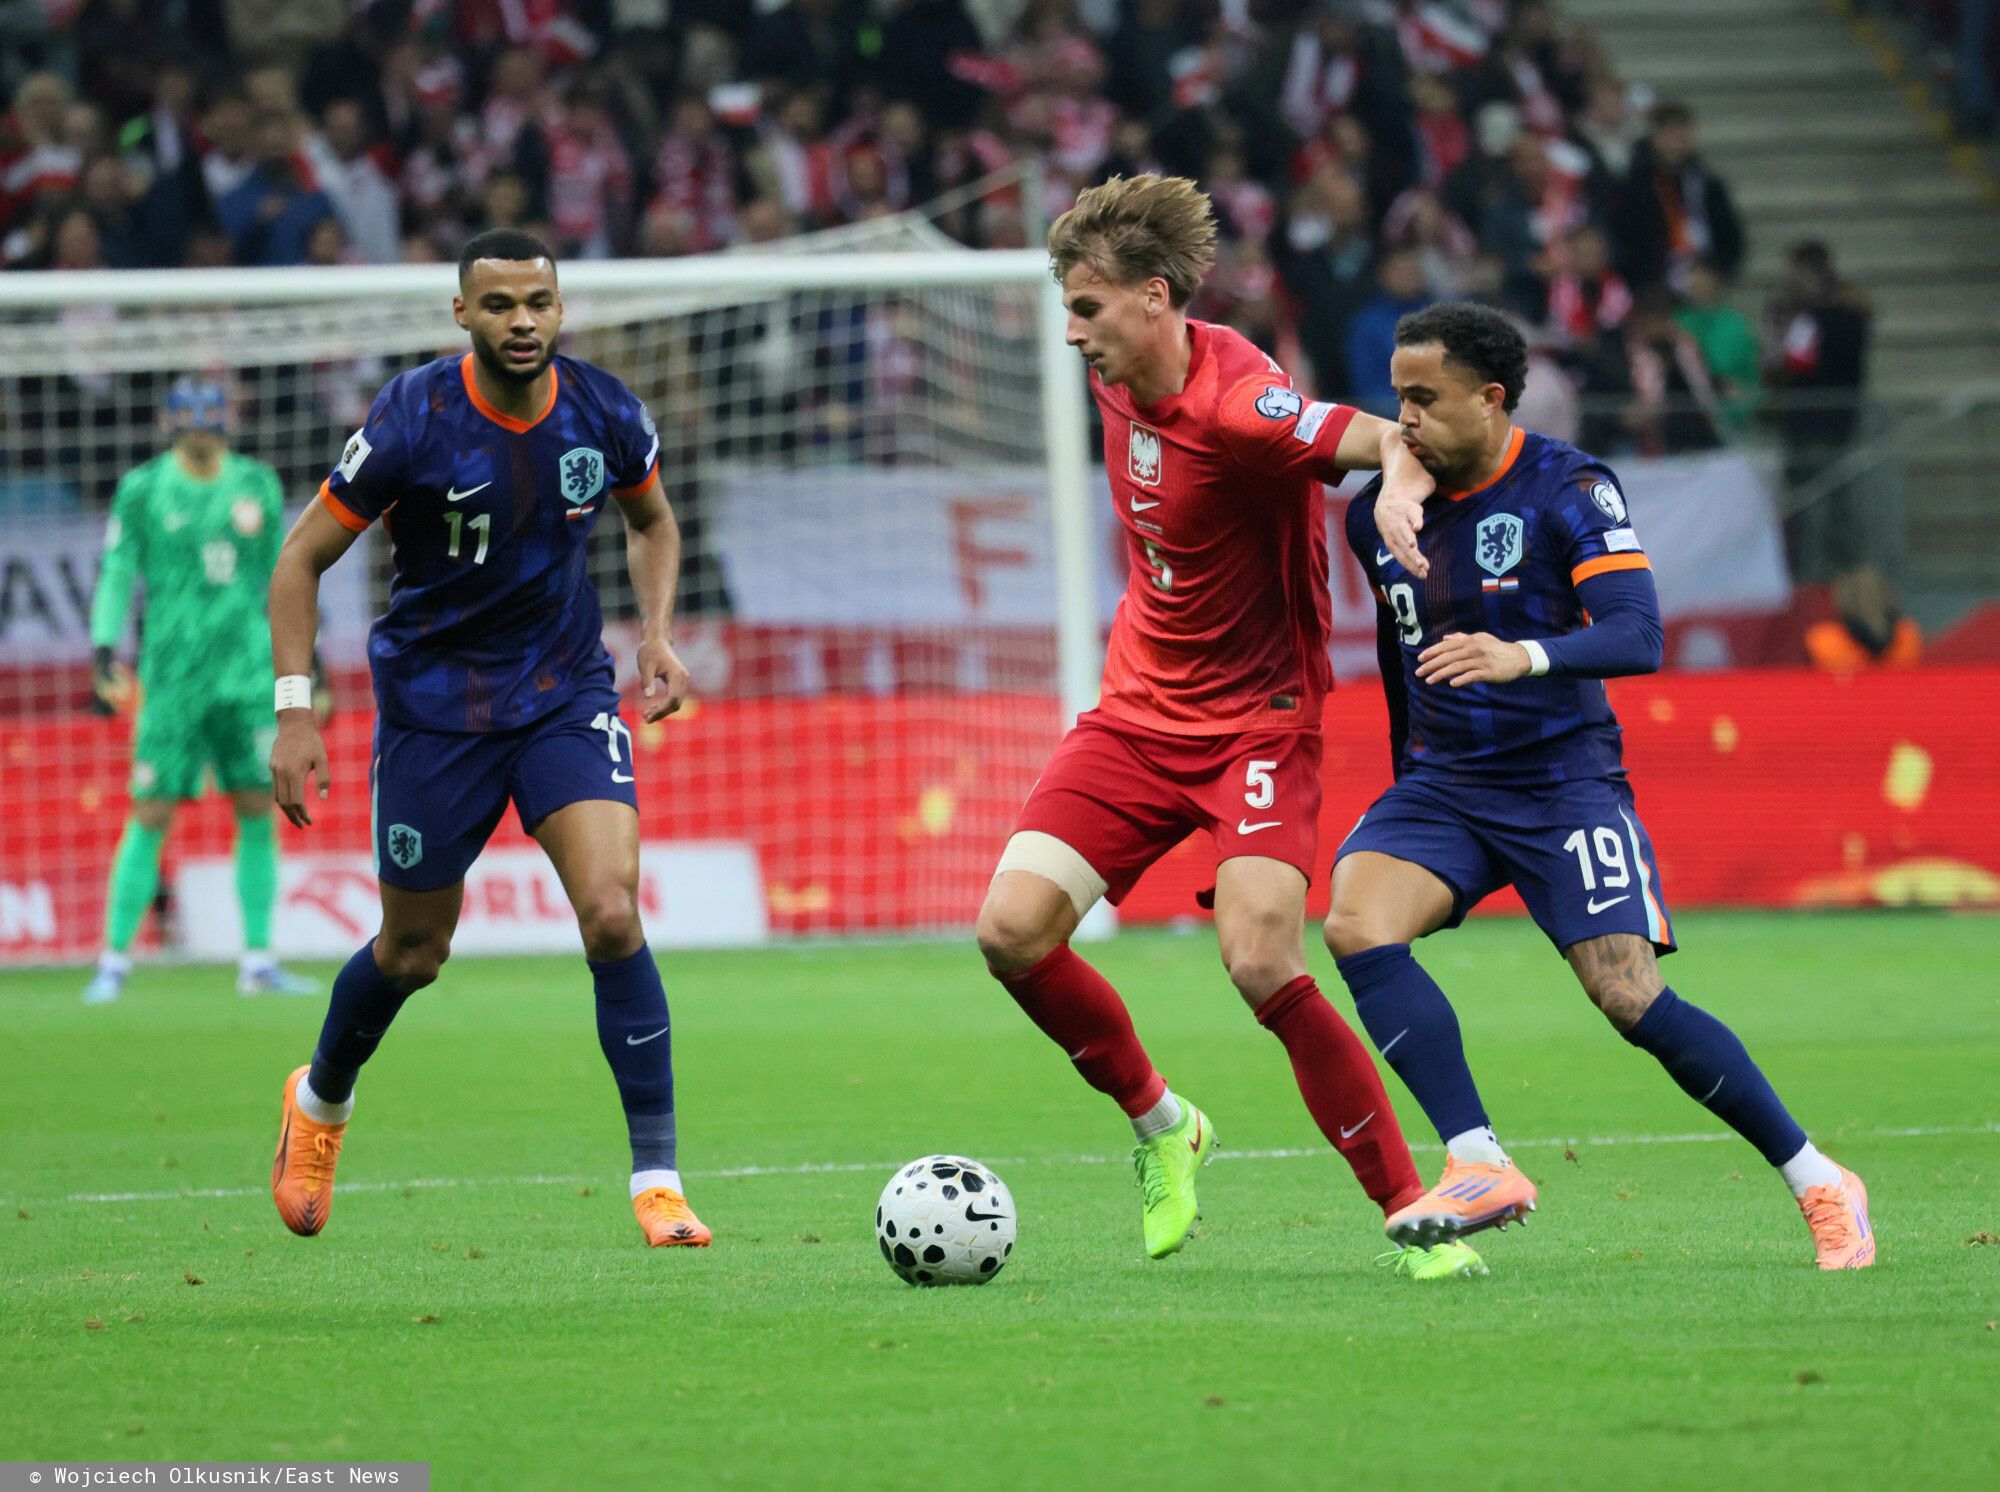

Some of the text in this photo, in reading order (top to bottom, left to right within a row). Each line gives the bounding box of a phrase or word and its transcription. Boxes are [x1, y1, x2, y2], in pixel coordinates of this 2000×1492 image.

[443, 511, 490, 565] 11
[1143, 537, 1173, 592] 5
[1381, 583, 1423, 646] 9
[590, 712, 633, 766] 11
[1245, 760, 1277, 809] 5
[1563, 826, 1630, 890] 19
